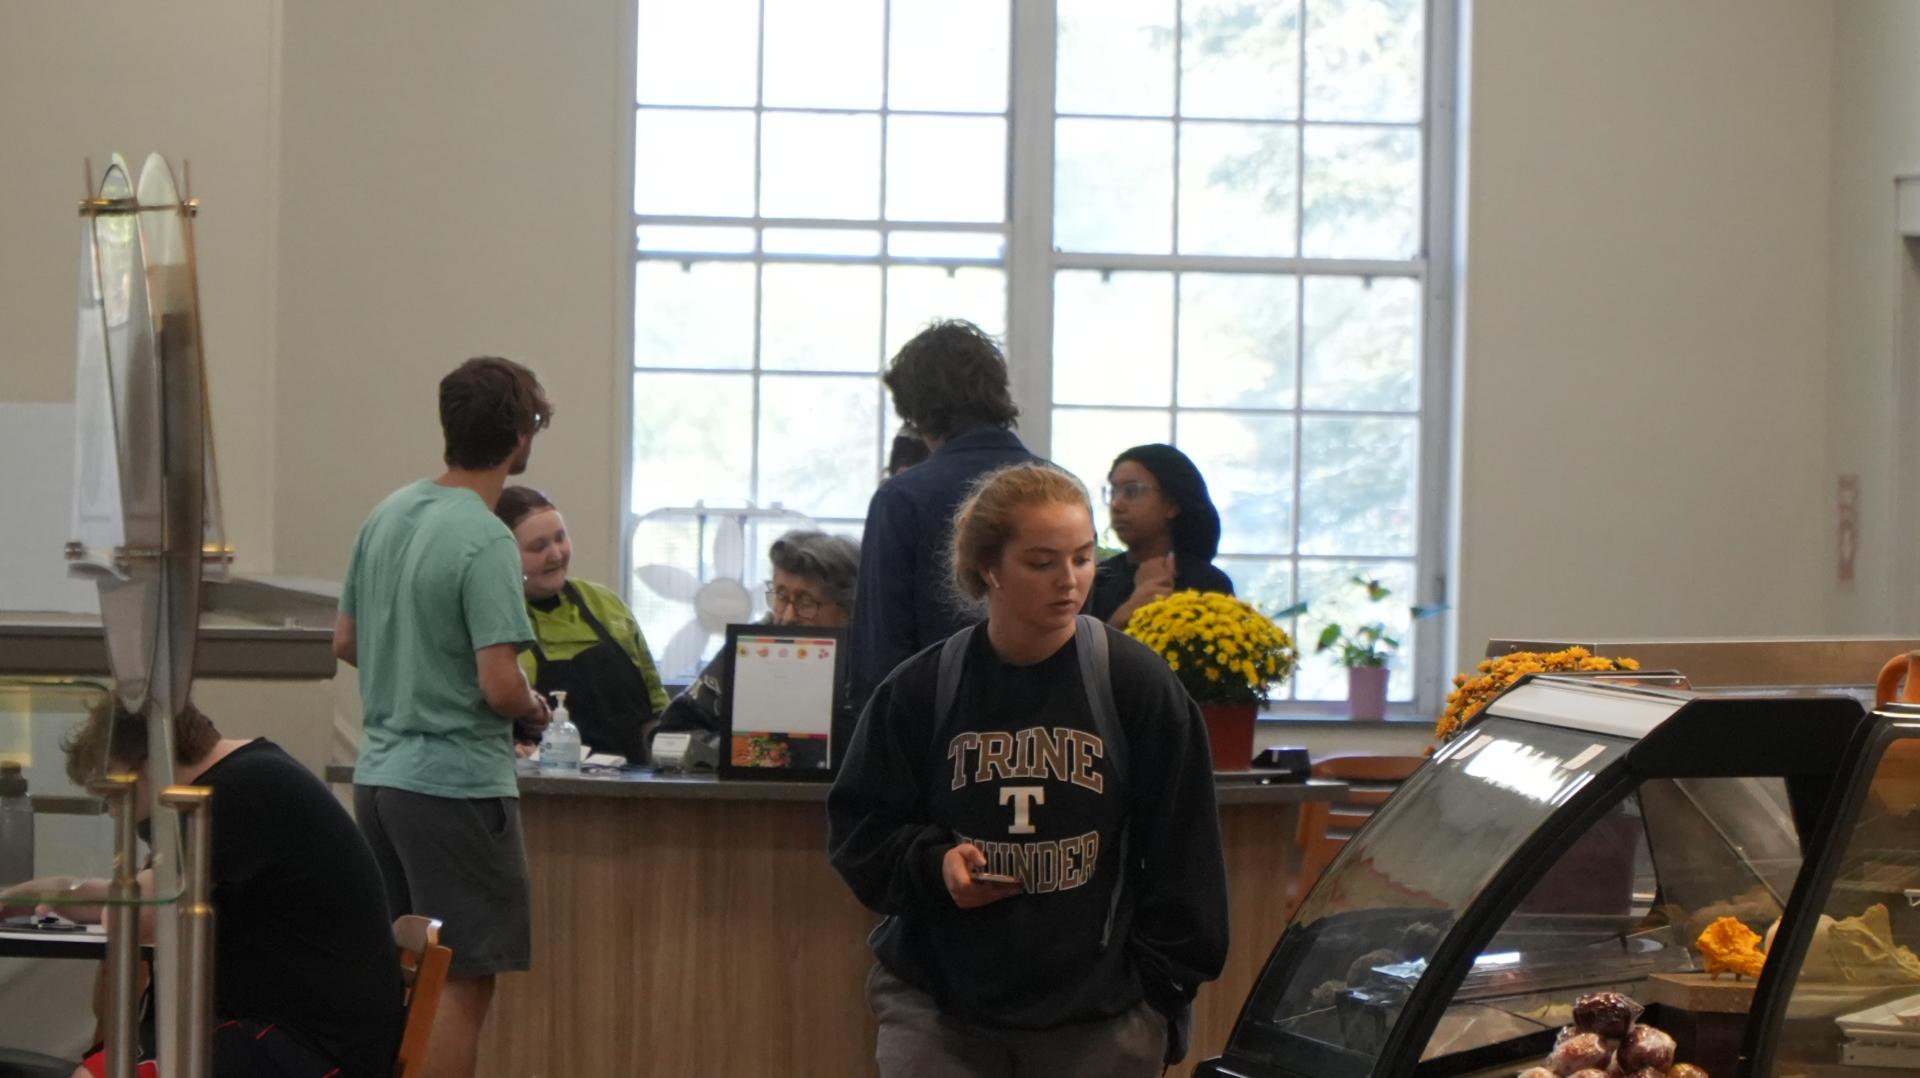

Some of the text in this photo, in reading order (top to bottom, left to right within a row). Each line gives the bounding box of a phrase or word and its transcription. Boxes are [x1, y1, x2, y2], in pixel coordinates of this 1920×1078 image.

[948, 727, 1103, 794] TRINE
[999, 786, 1045, 834] T
[952, 830, 1099, 894] UNDER
